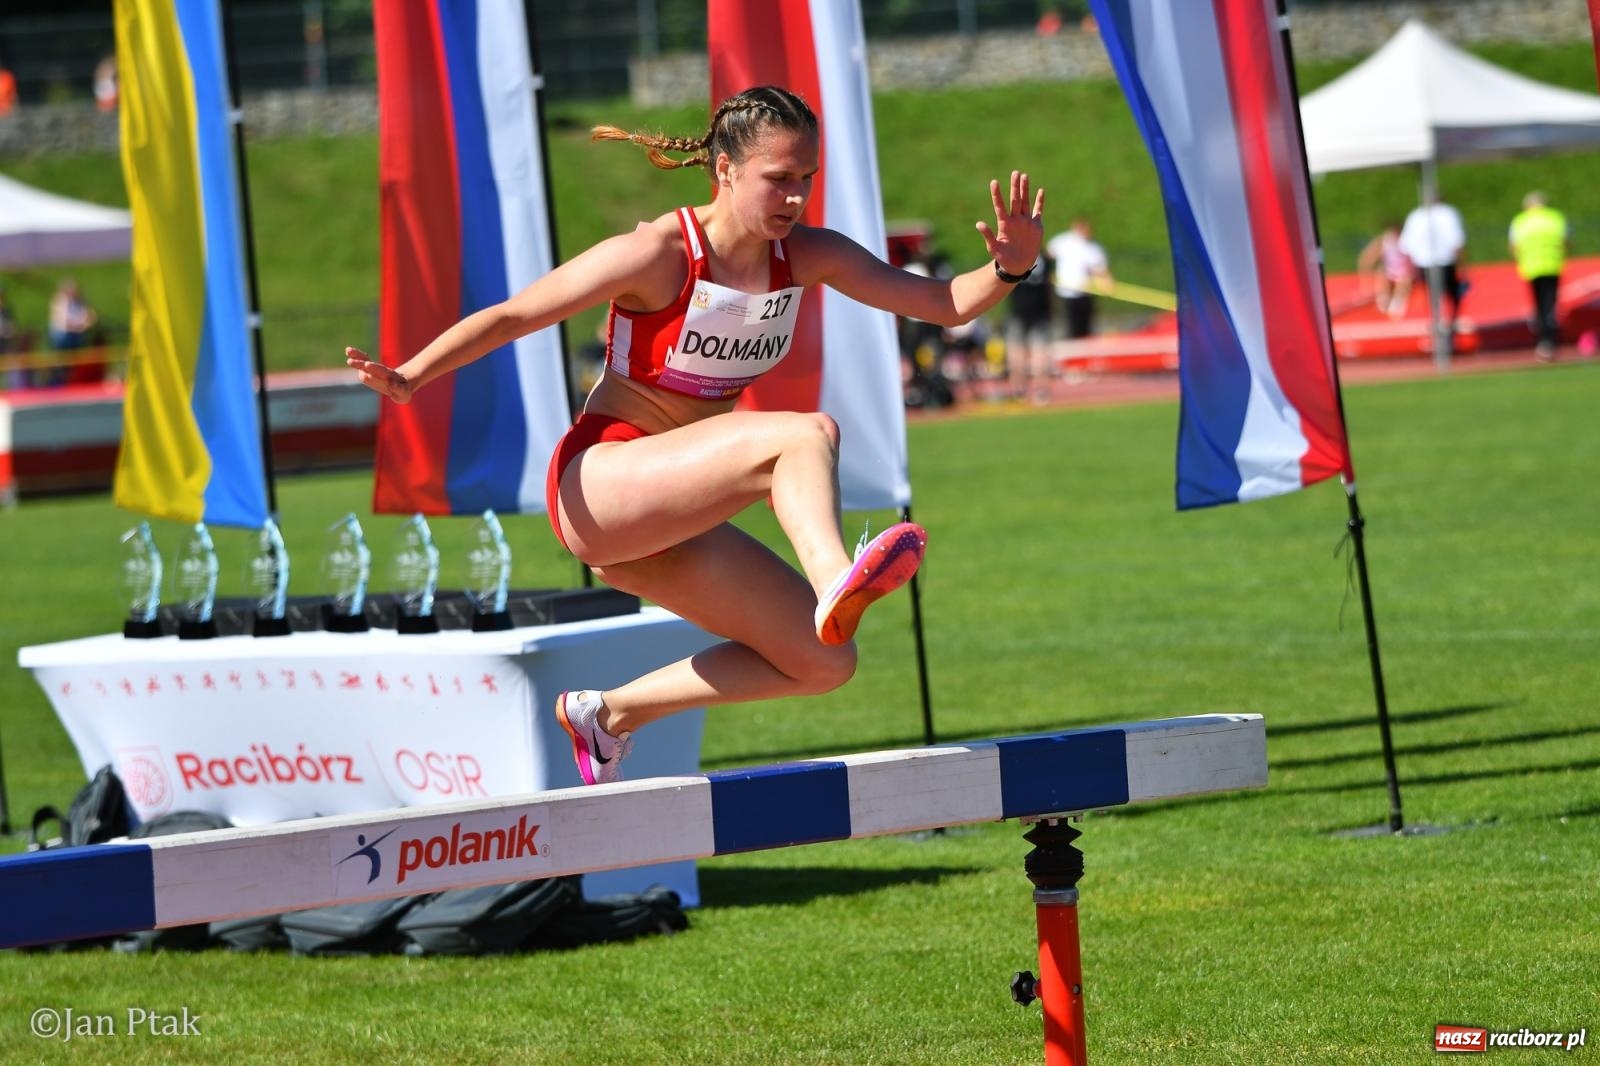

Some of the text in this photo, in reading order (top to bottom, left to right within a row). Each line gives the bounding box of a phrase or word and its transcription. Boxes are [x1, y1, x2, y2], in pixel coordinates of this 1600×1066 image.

[760, 294, 793, 320] 217
[681, 330, 789, 361] DOLMÁNY
[174, 743, 488, 797] Racibórz OSiR
[397, 814, 541, 885] polanik
